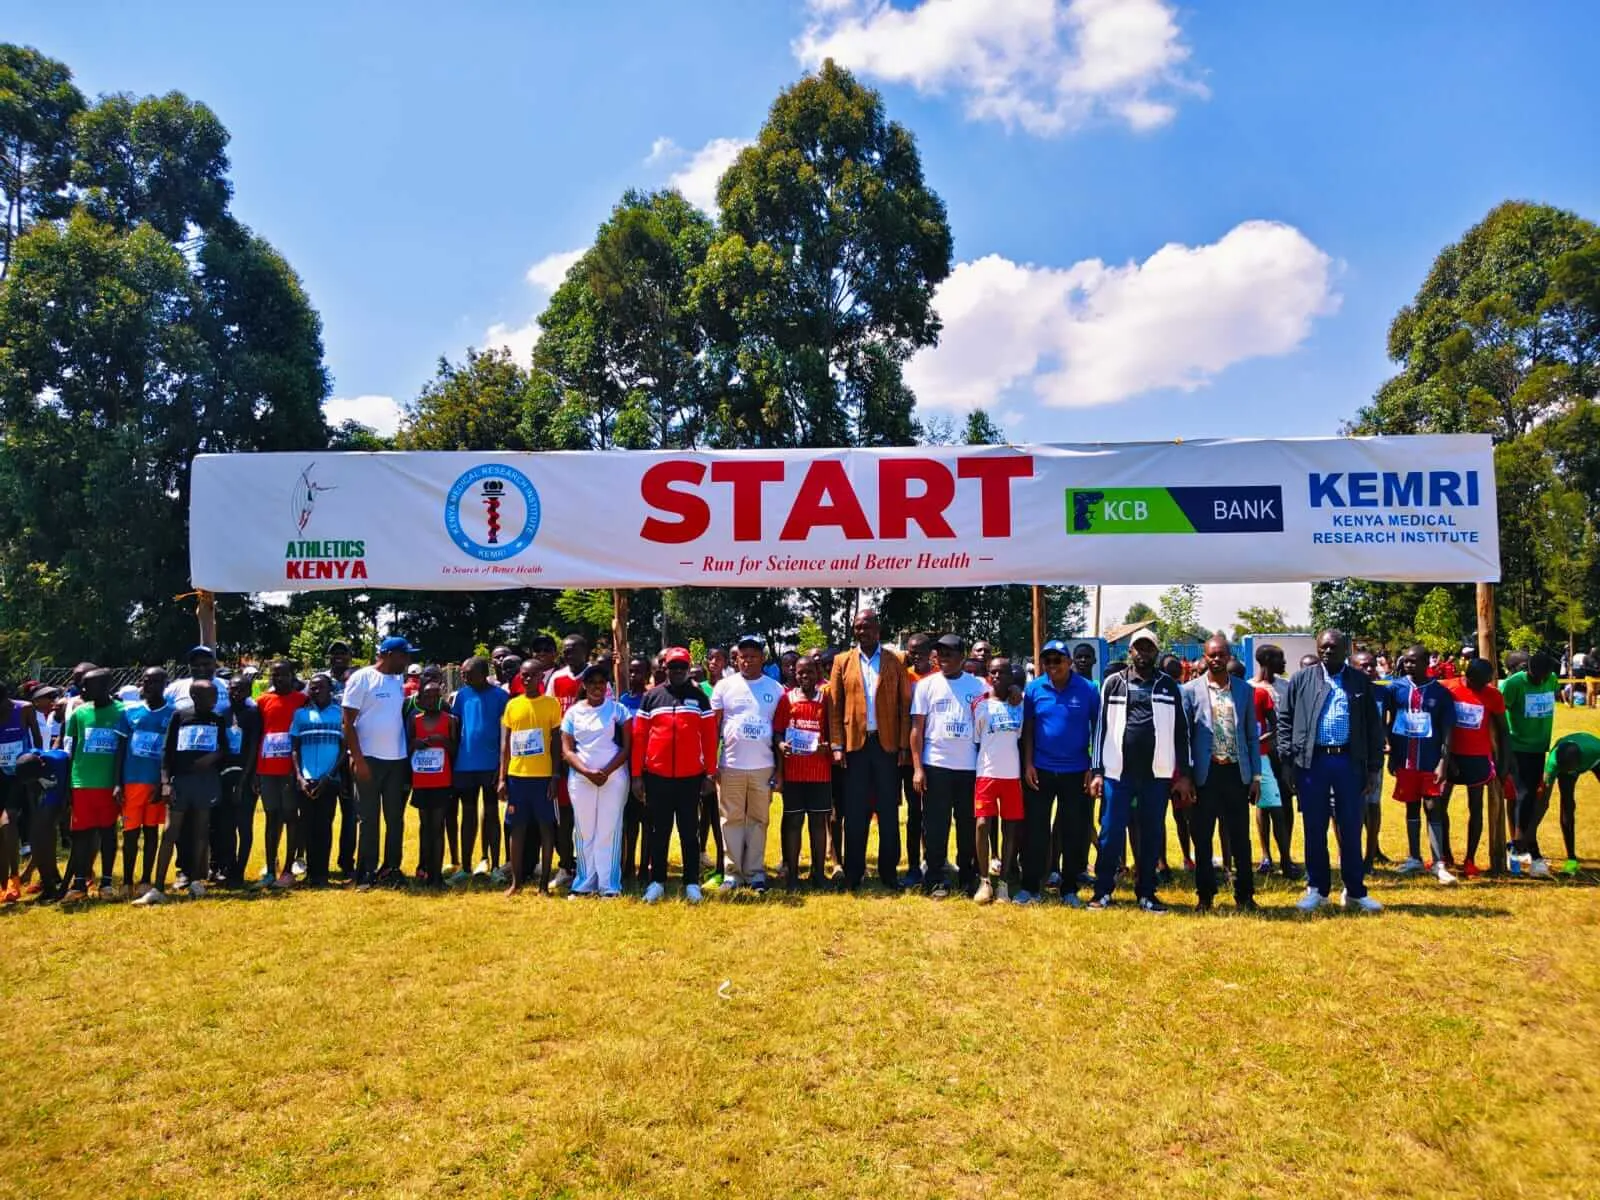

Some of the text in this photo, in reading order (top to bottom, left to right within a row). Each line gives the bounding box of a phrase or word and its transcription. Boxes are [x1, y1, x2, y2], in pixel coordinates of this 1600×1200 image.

[1309, 471, 1479, 508] KEMRI
[447, 466, 538, 536] KENYA MEDICAL RESEARCH INSTITUTE
[640, 456, 1034, 544] START
[1104, 499, 1275, 521] KCB BANK
[1333, 513, 1457, 527] KENYA MEDICAL
[1313, 531, 1479, 545] RESEARCH INSTITUTE
[286, 540, 365, 558] ATHLETICS
[478, 550, 507, 559] KEMRI
[286, 560, 368, 579] KENYA
[442, 563, 543, 575] In Search of Better Health
[702, 552, 971, 577] Run for Science and Better Health
